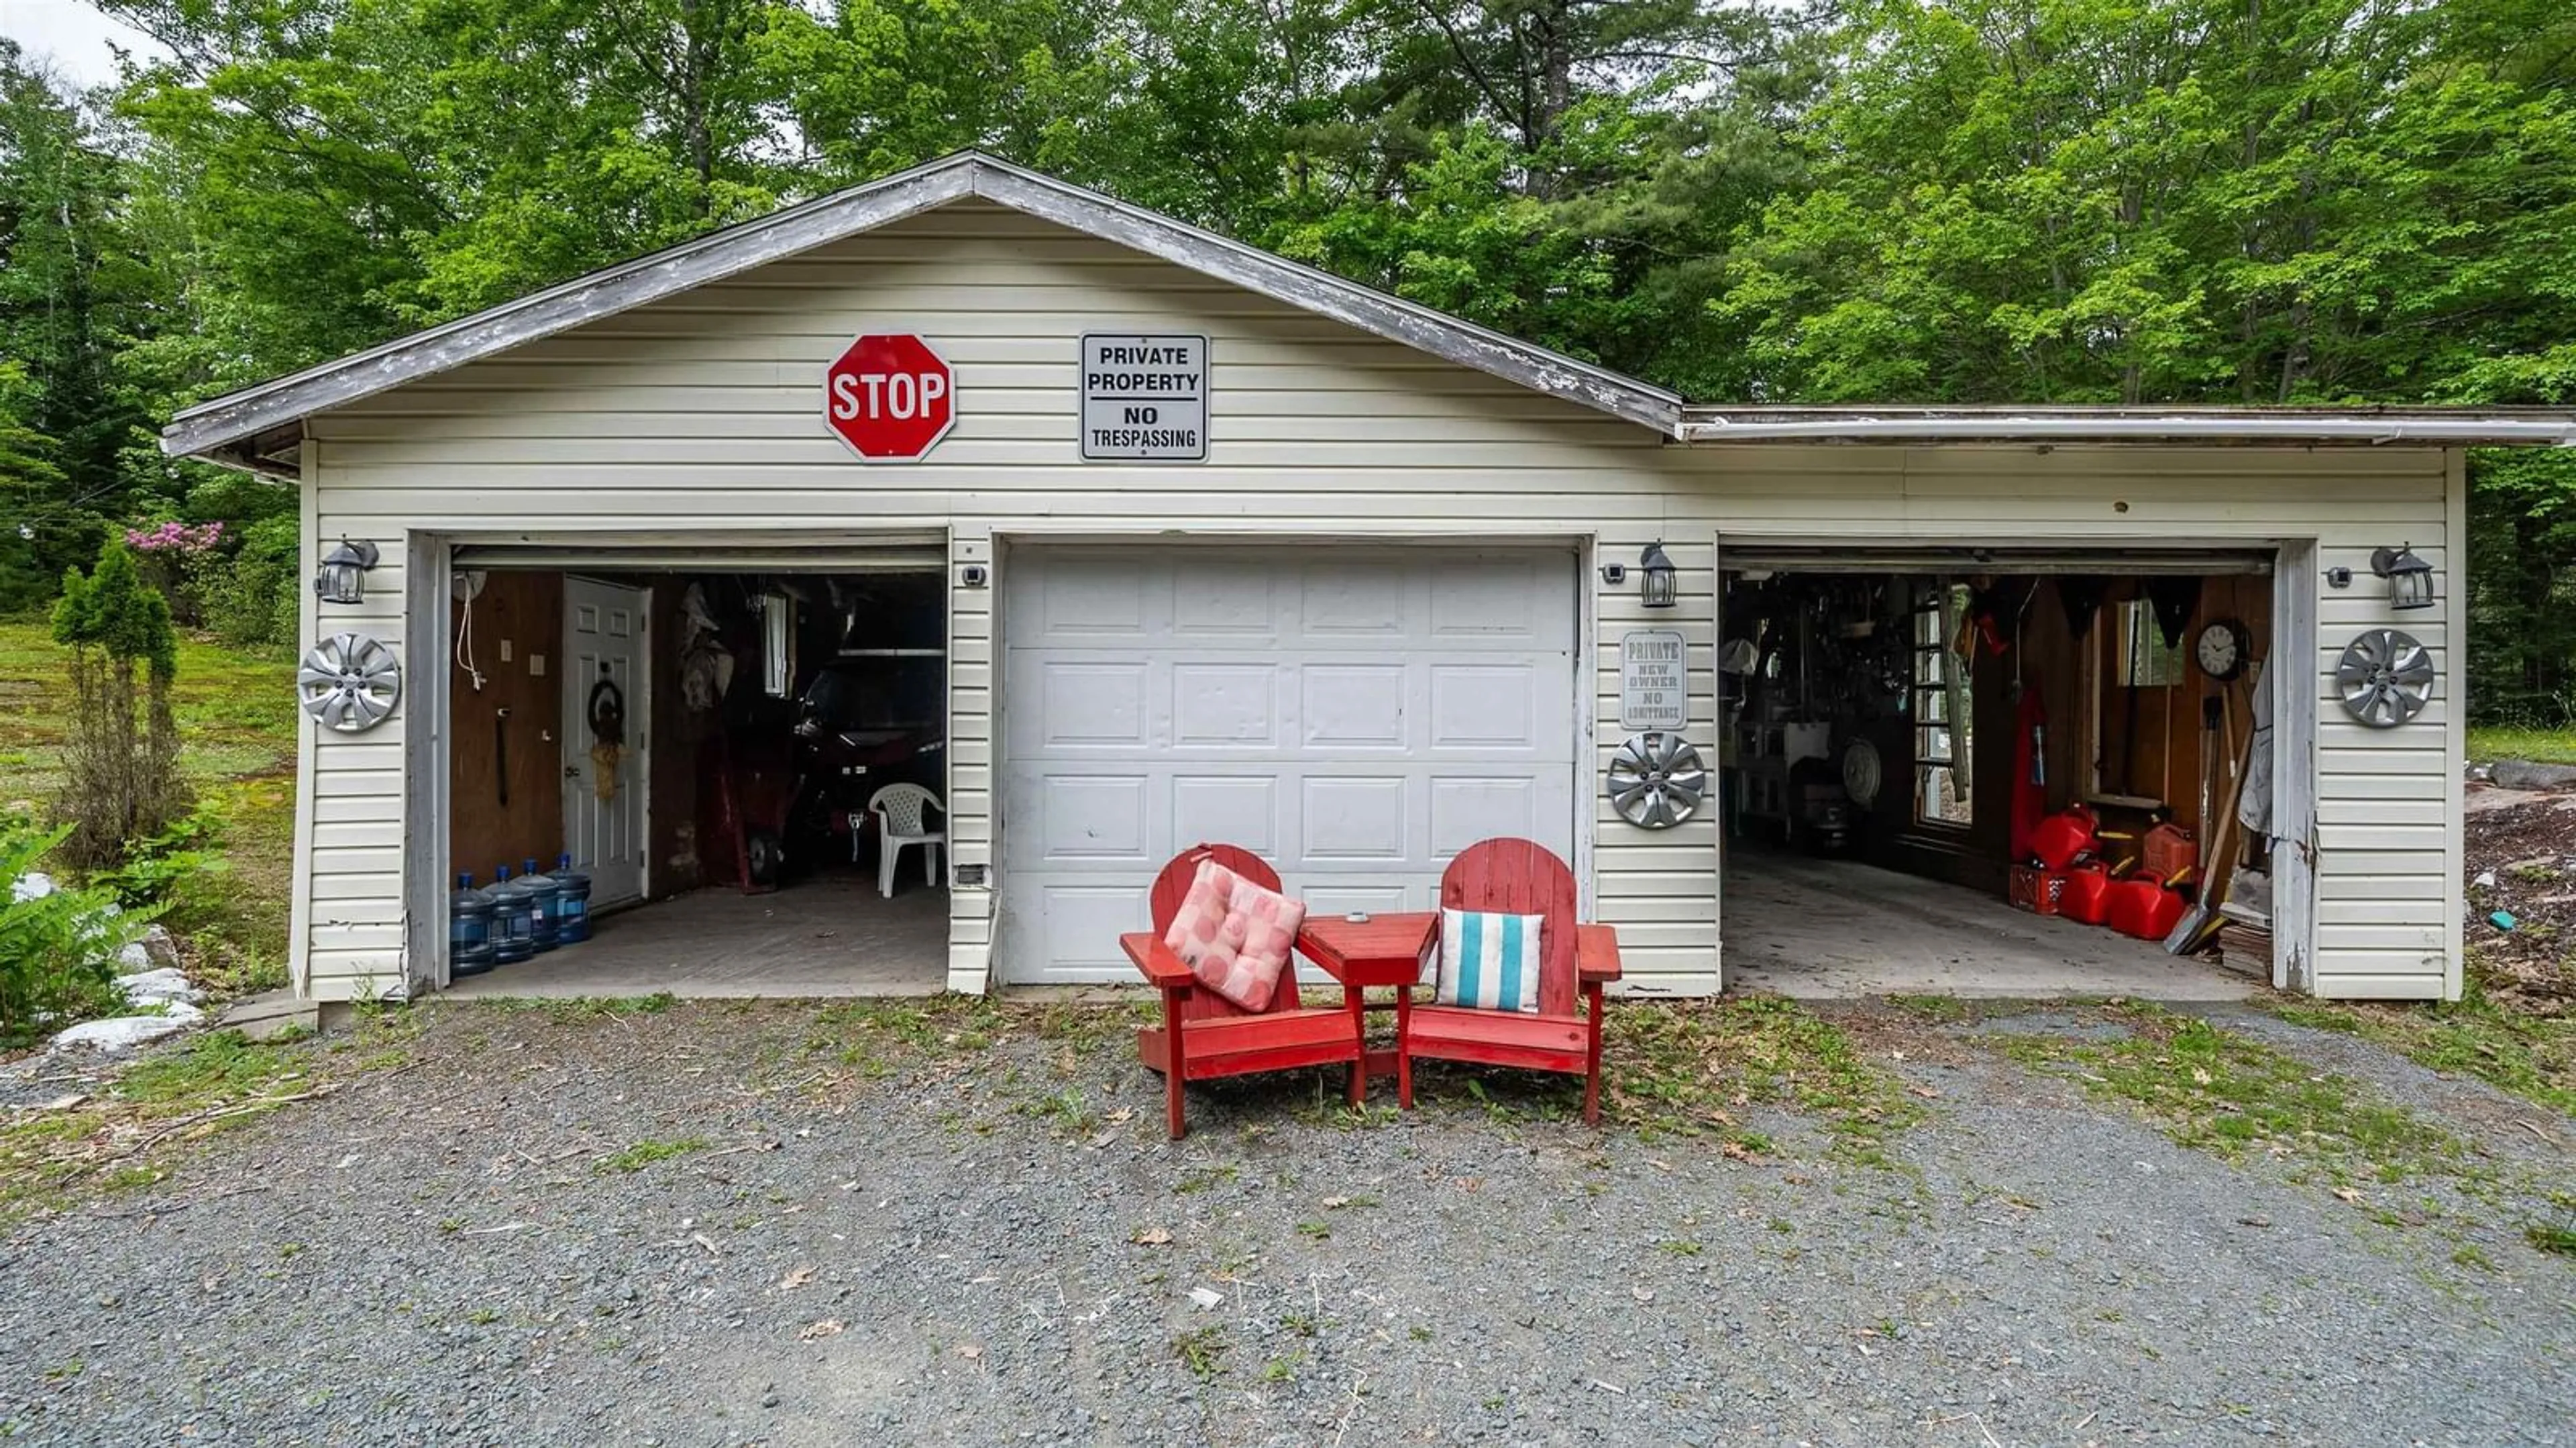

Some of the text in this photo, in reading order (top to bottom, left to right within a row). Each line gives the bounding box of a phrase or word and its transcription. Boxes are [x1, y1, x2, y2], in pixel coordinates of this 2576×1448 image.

[1100, 348, 1188, 364] PRIVATE
[1088, 373, 1199, 391] PROPERTY
[833, 373, 945, 420] STOP
[1124, 407, 1158, 425] NO
[1092, 429, 1196, 448] TRESPASSING
[1629, 642, 1678, 660] PRIVATE
[1639, 665, 1668, 675] NEW
[1629, 676, 1677, 687] OWNER
[1644, 692, 1662, 705] NO
